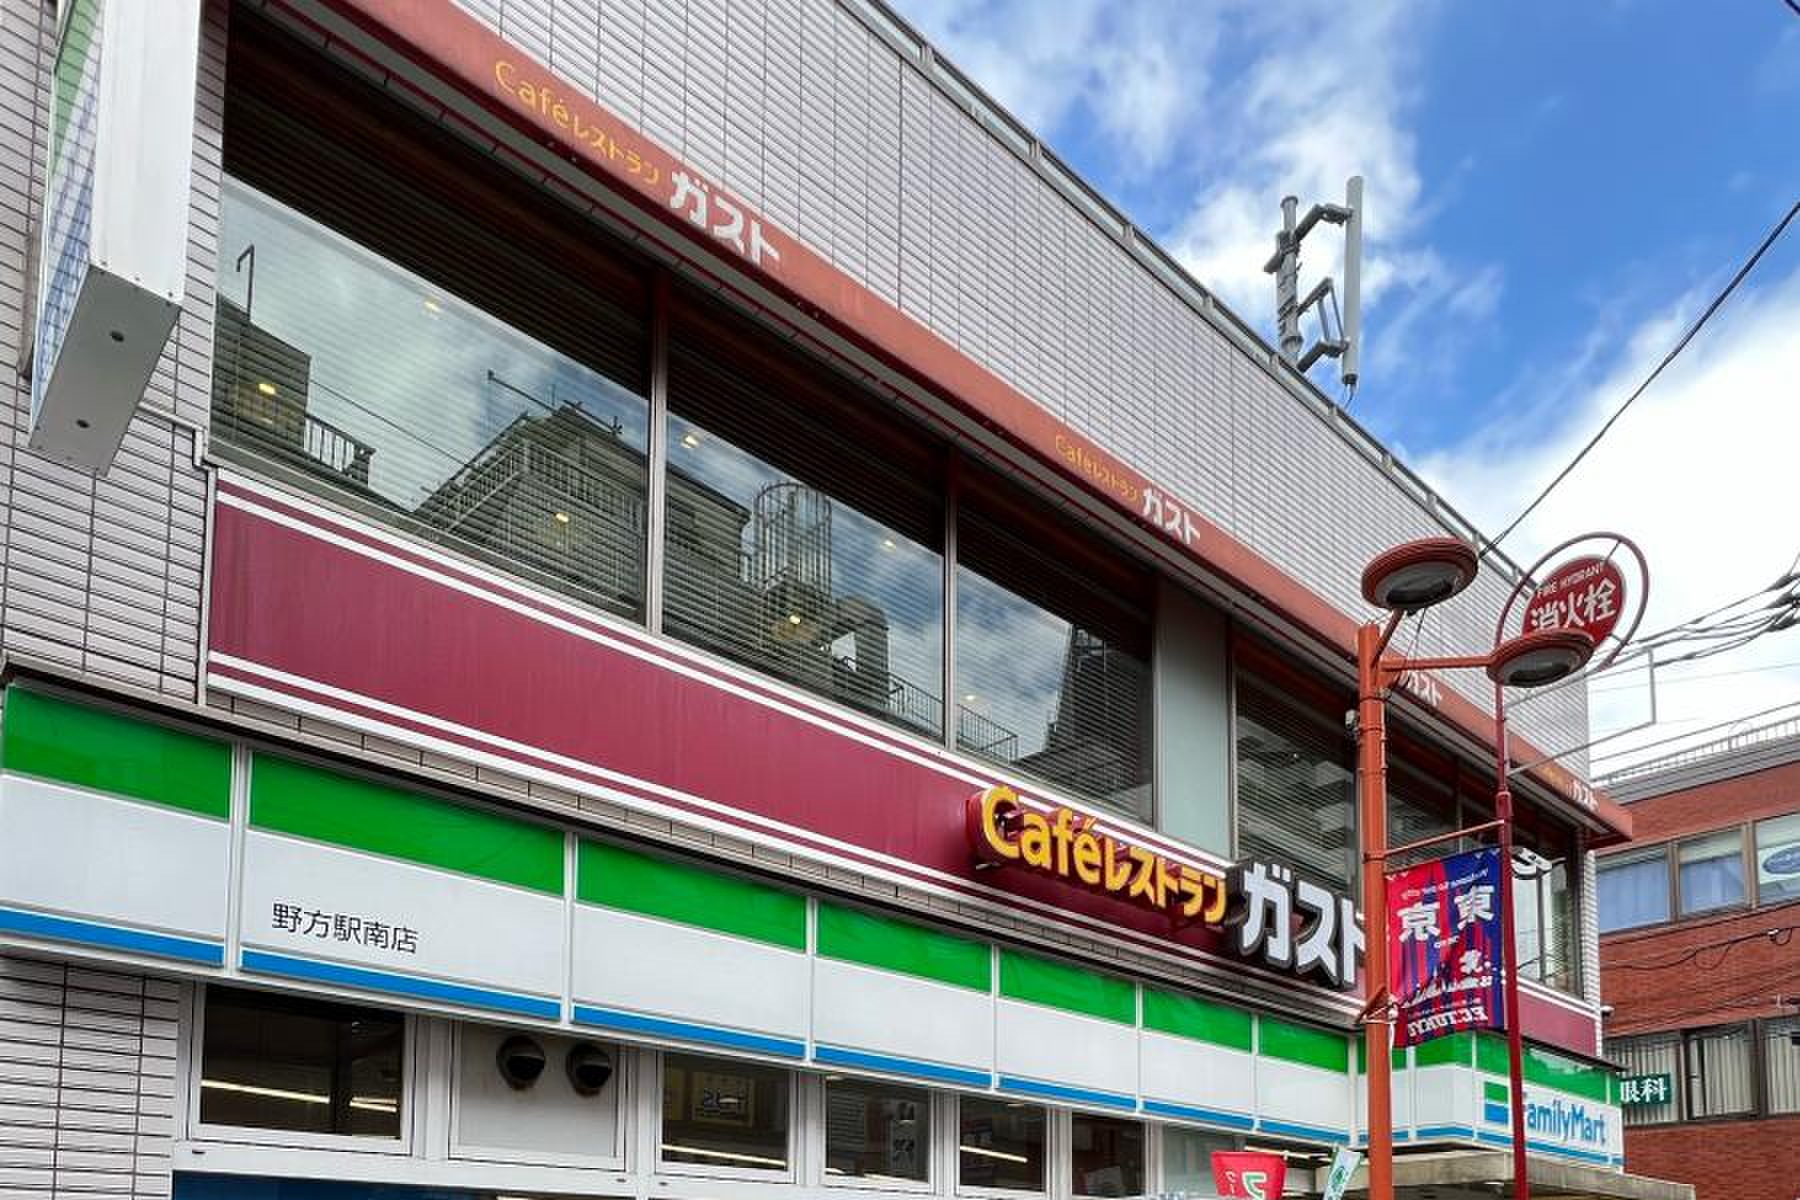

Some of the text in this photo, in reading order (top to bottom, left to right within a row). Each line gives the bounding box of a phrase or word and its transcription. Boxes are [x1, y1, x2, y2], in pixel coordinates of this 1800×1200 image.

[669, 170, 780, 266] ガスト
[1142, 487, 1201, 545] ガスト
[1531, 577, 1617, 630] 消火栓
[979, 784, 1227, 924] Caféレストラン
[1240, 861, 1366, 985] ガスト
[272, 902, 419, 954] 野方駅南店
[1619, 1076, 1667, 1103] 眼科
[1522, 1092, 1606, 1144] amilyMart
